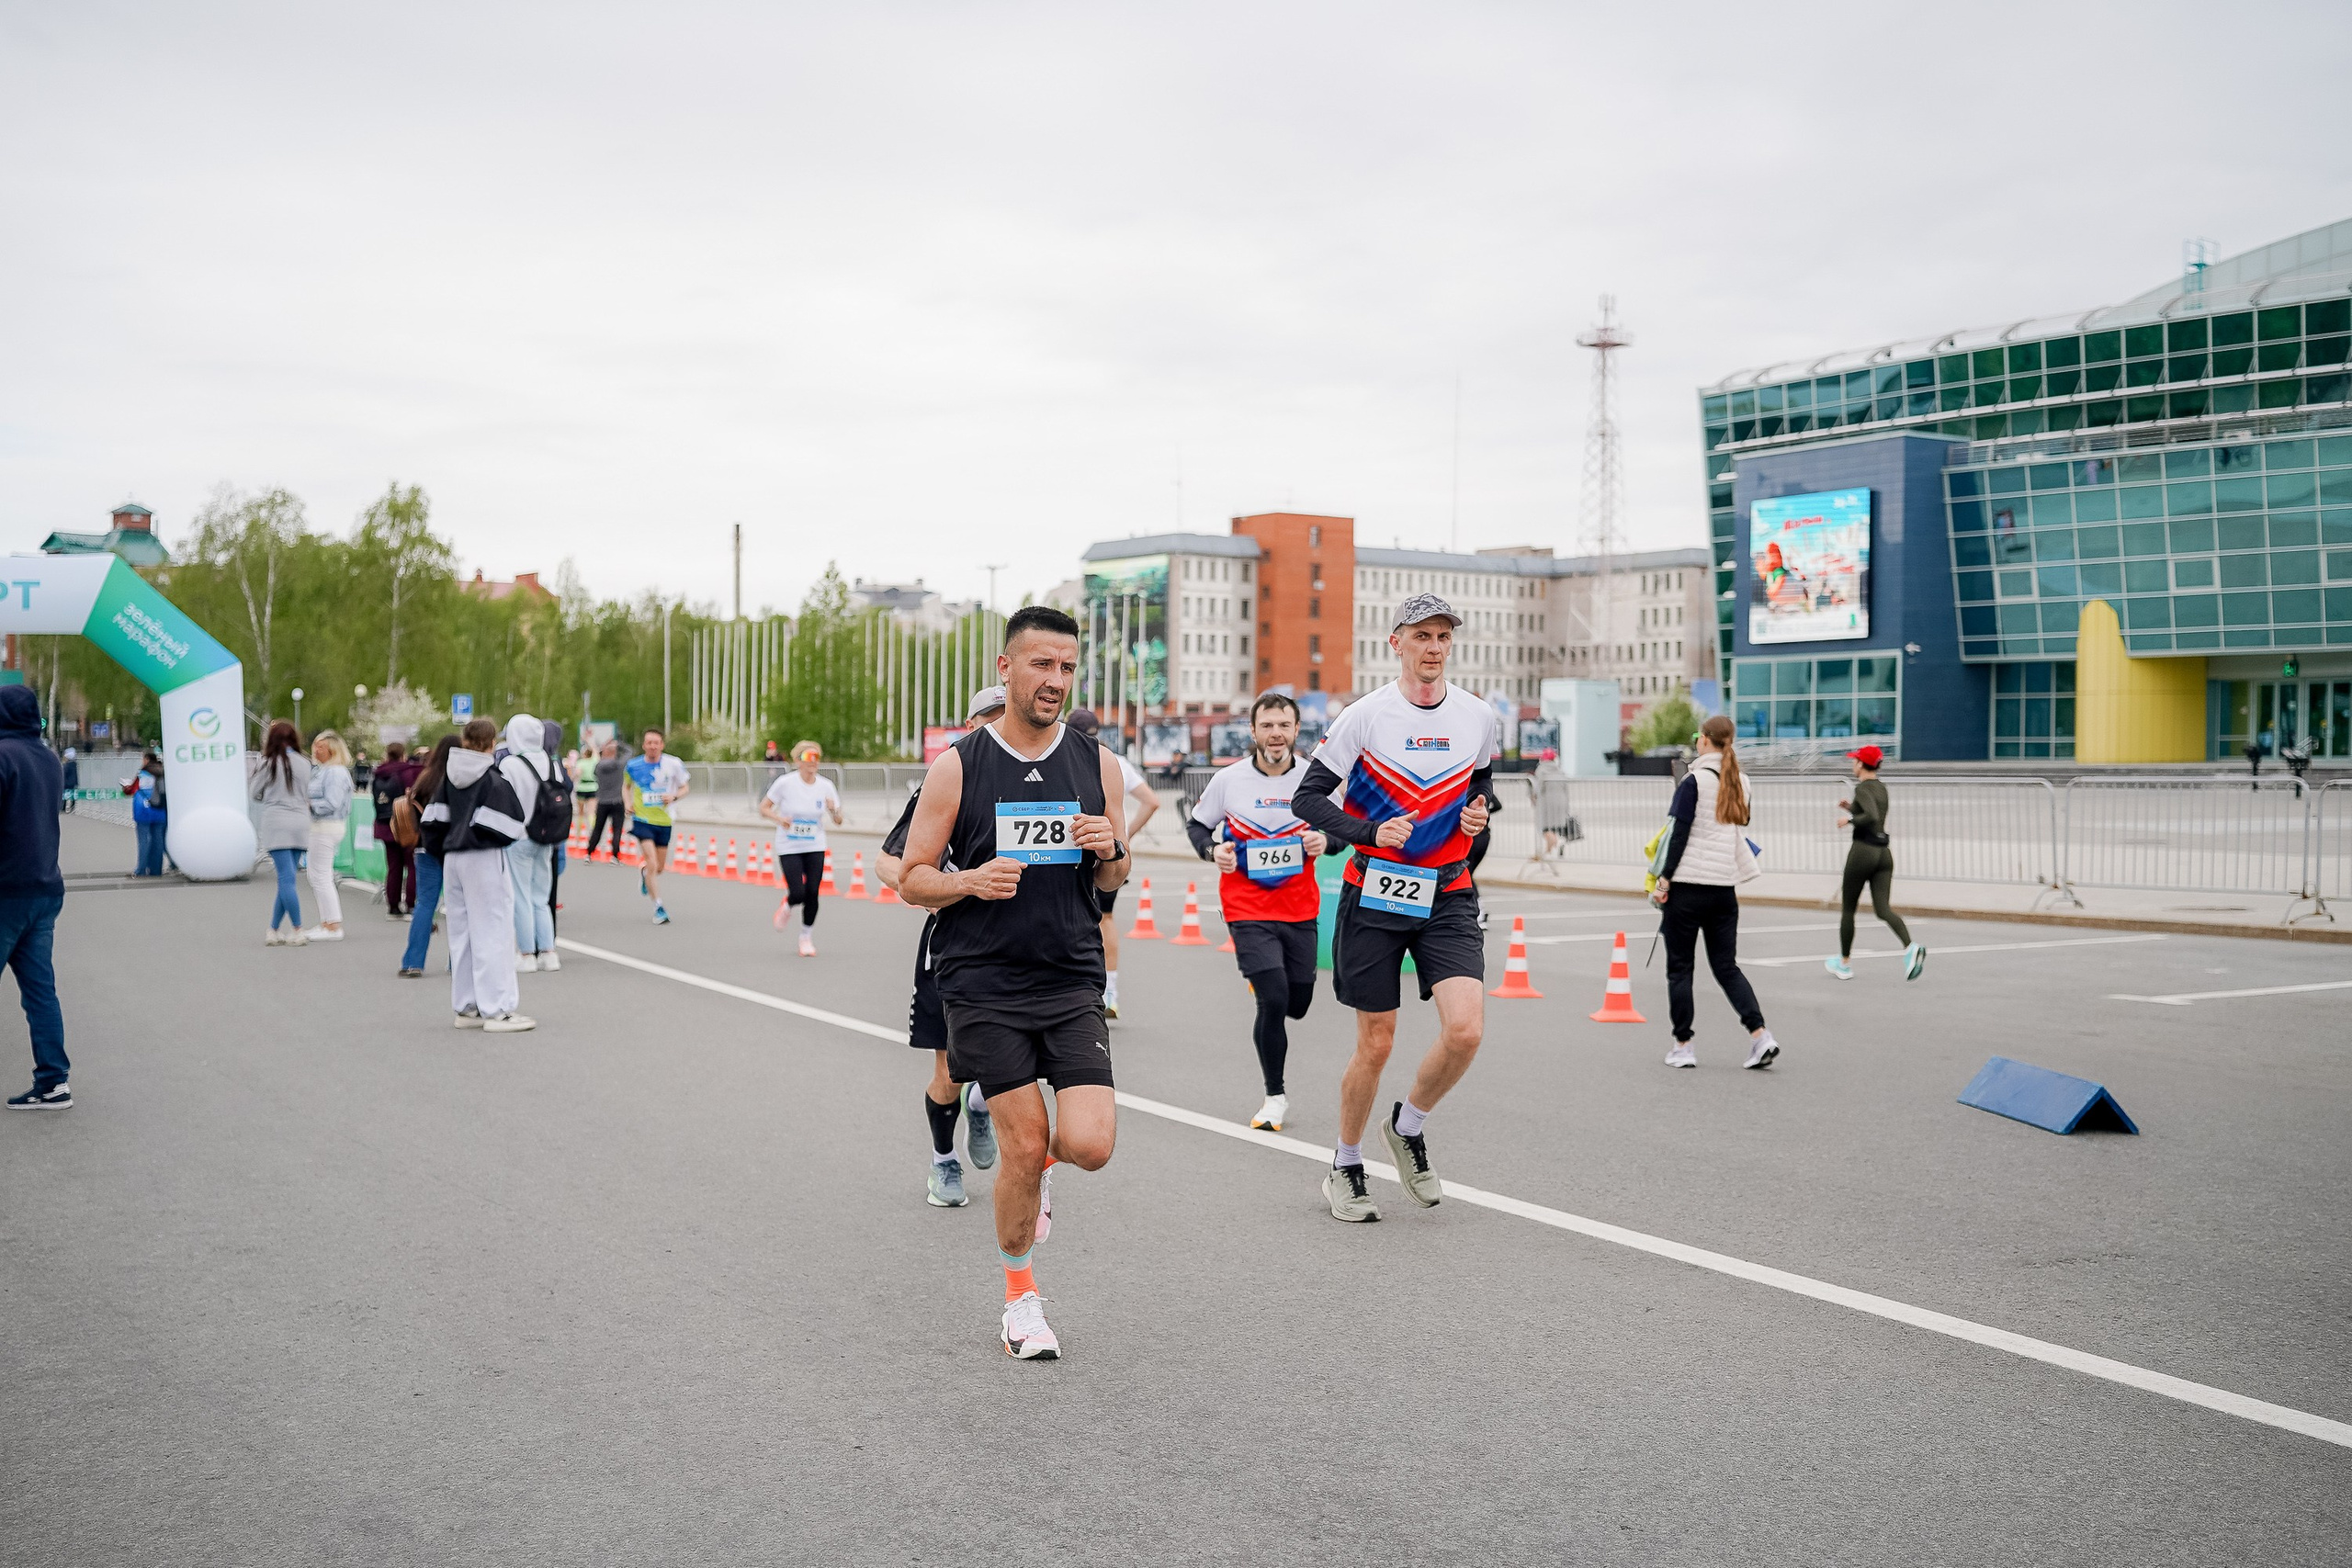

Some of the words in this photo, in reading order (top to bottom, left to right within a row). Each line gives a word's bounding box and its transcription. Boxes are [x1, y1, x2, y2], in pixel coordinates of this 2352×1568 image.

[112, 612, 177, 670] марафон
[123, 602, 191, 660] зелёный
[175, 742, 237, 763] СБЕР
[1014, 820, 1065, 844] 728
[1260, 849, 1291, 865] 966
[1379, 875, 1420, 901] 922
